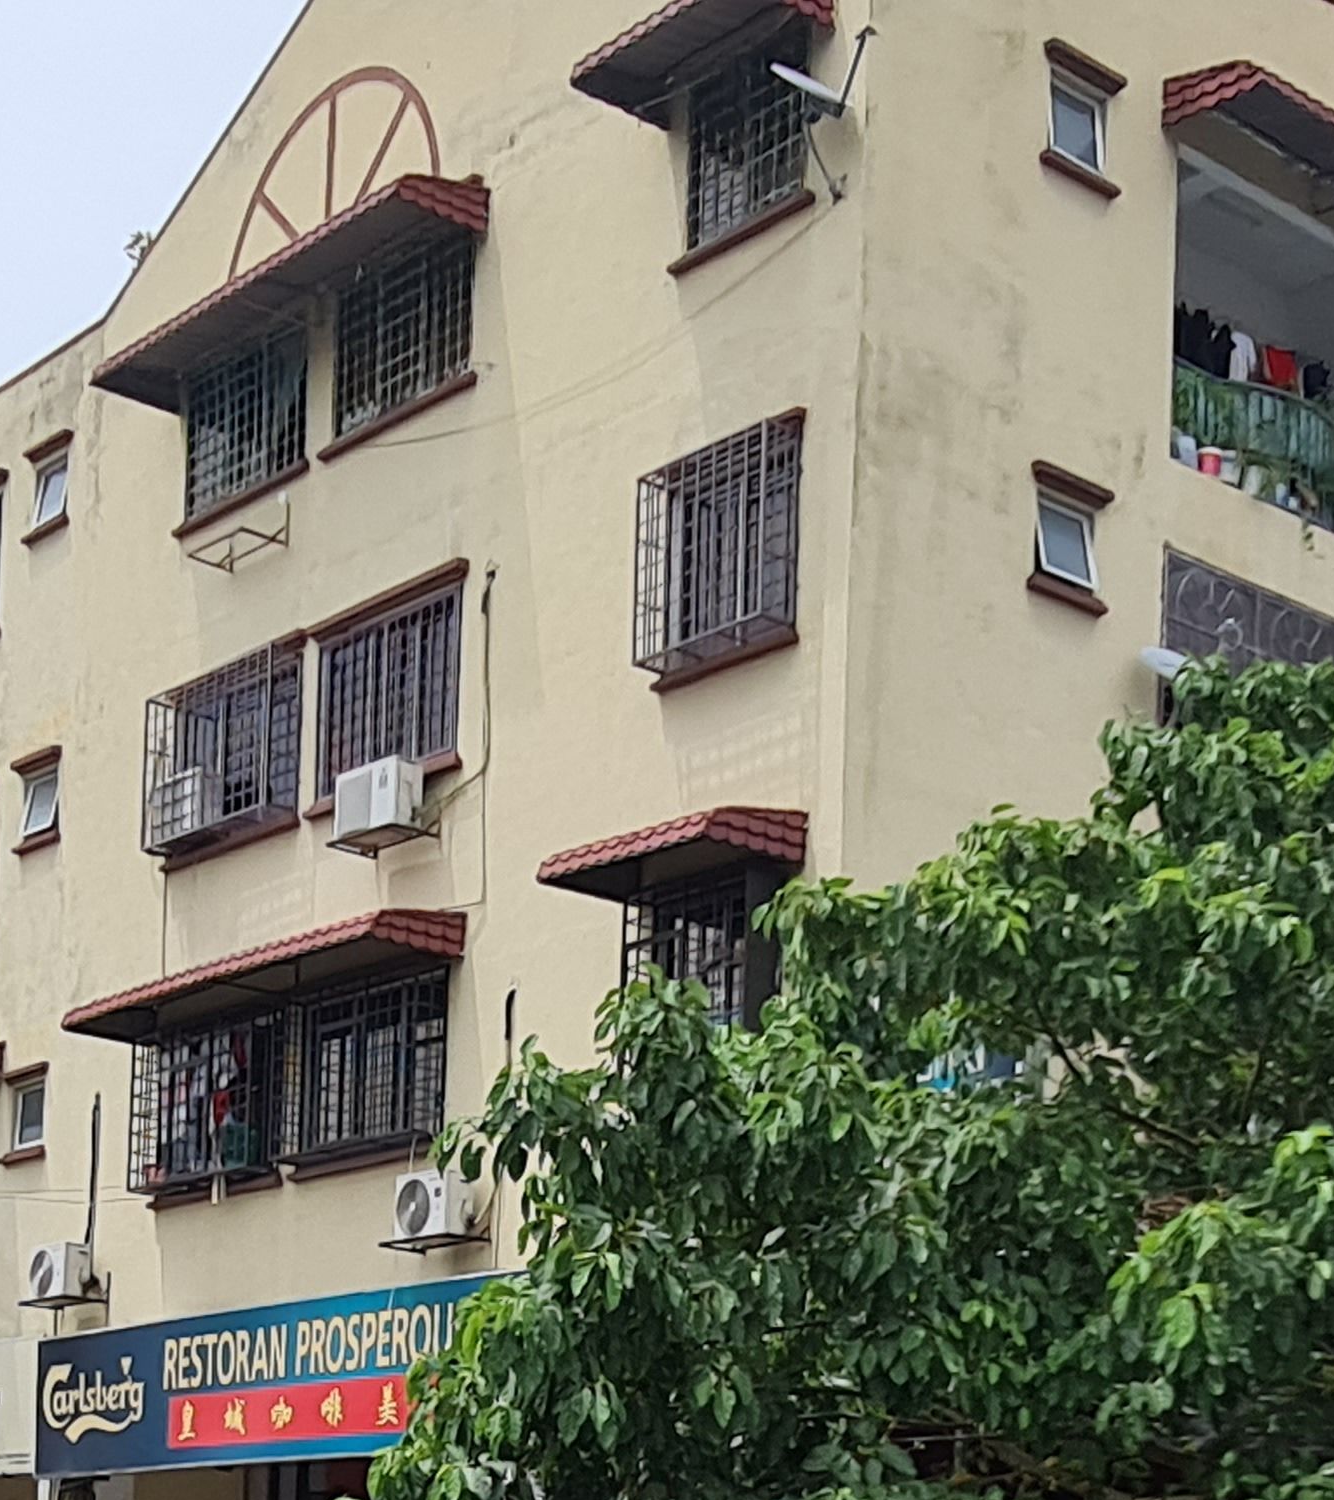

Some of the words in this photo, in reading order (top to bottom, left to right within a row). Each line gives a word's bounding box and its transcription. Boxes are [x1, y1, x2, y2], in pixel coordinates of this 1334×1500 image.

[163, 1323, 287, 1390] RESTORAN
[295, 1302, 454, 1376] PROSPEROU
[42, 1357, 146, 1443] Carlsberg
[177, 1381, 399, 1441] 皇城咖啡美
